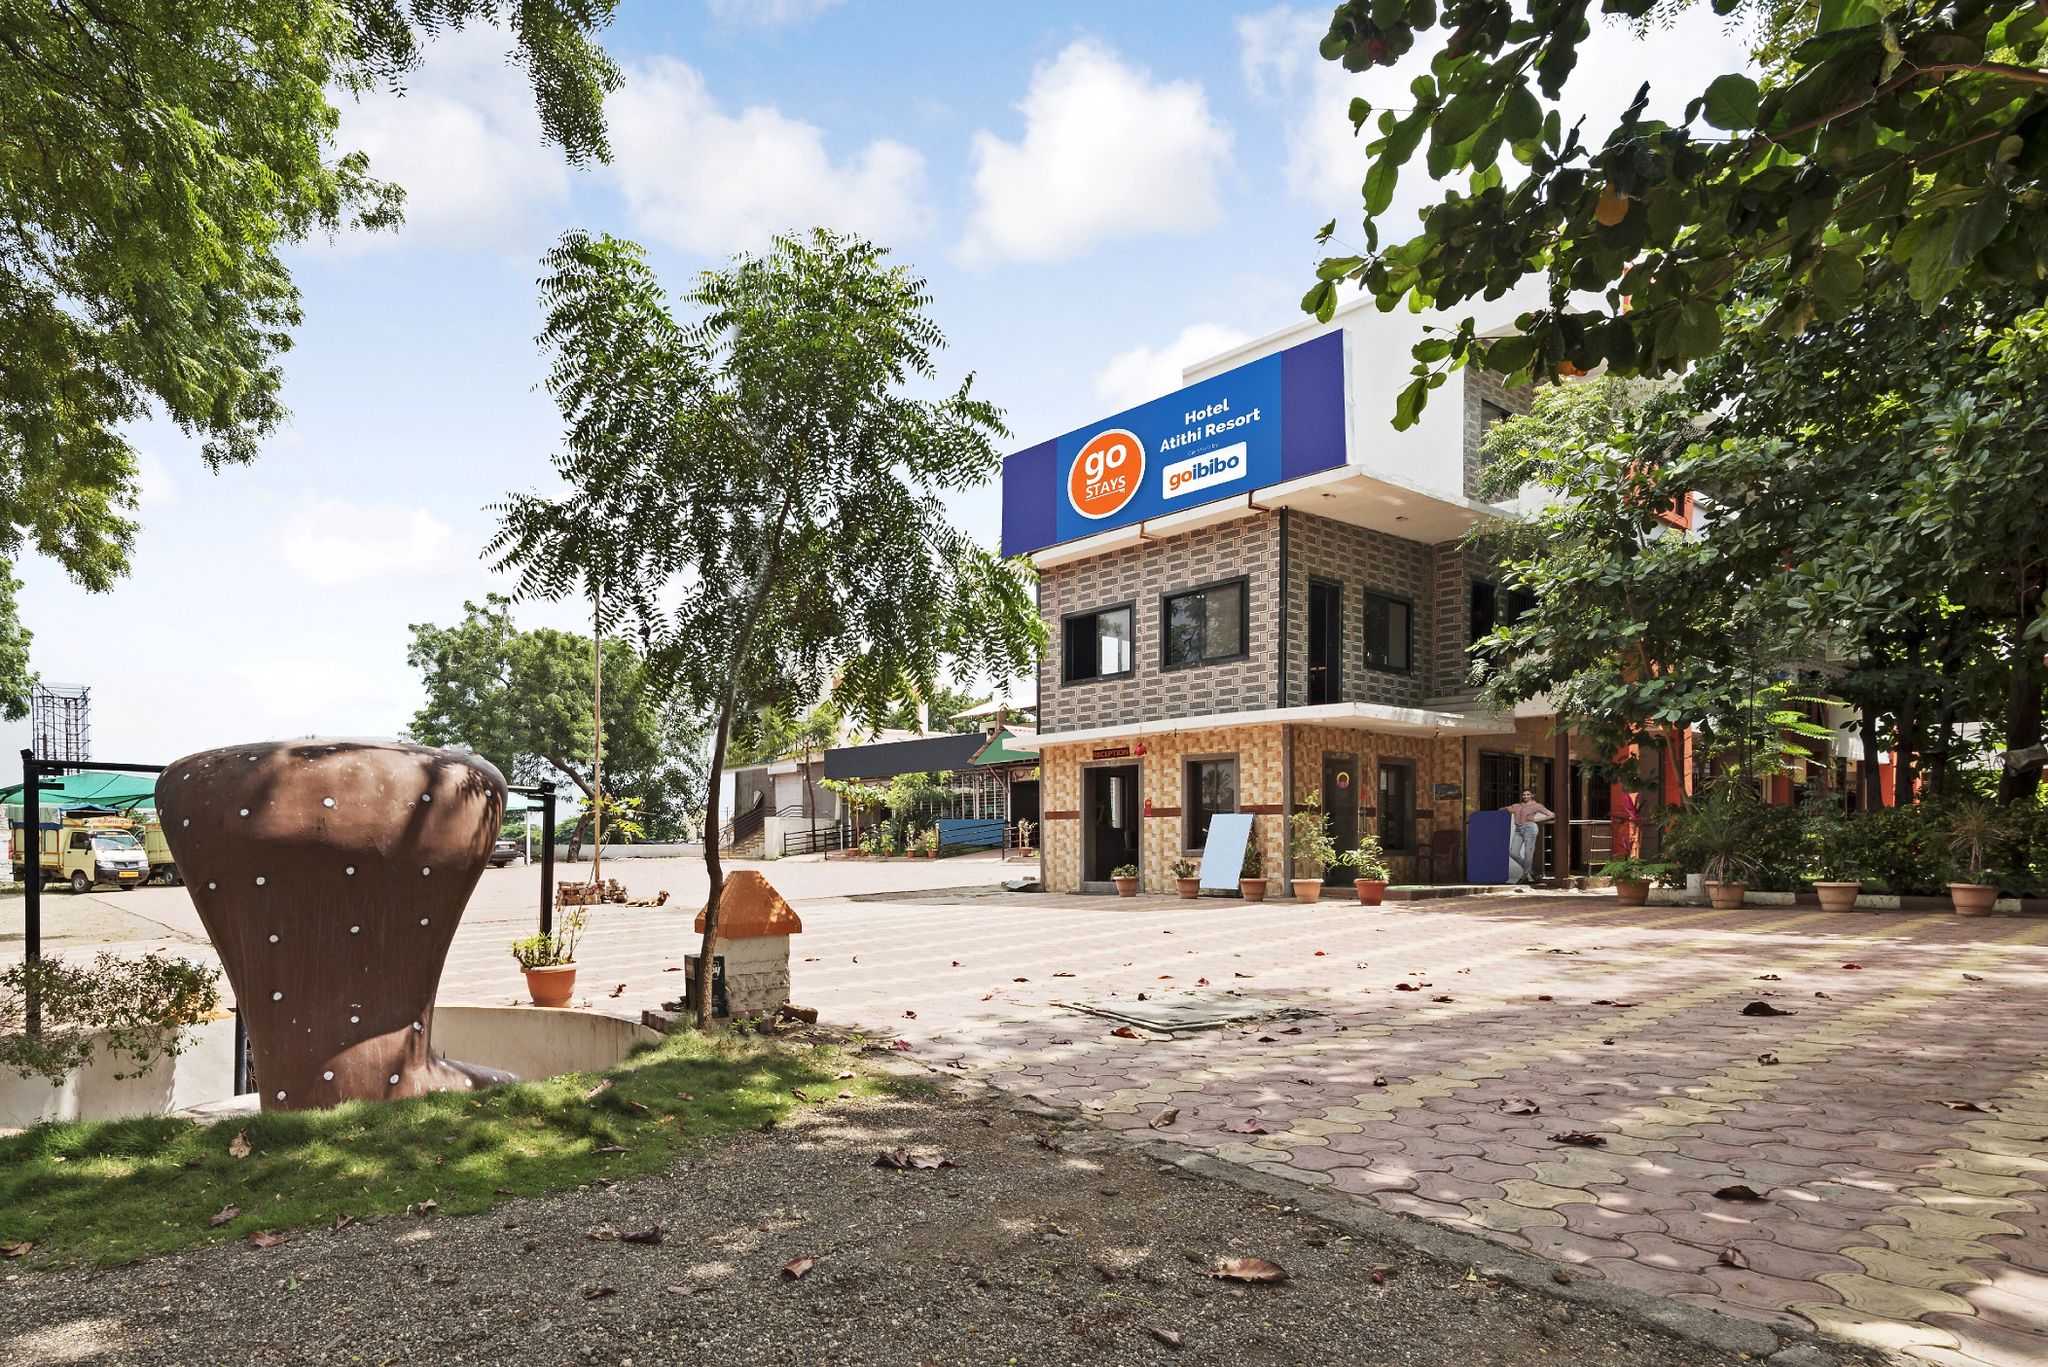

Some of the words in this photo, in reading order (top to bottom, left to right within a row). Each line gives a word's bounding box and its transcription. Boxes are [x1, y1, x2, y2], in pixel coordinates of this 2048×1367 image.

[1185, 398, 1230, 425] Hotel
[1160, 427, 1202, 453] Atithi
[1205, 408, 1261, 437] Resort
[1085, 444, 1127, 485] go
[1169, 456, 1240, 491] goibibo
[1086, 475, 1126, 499] STAYS
[1093, 749, 1129, 758] RECEPTION
